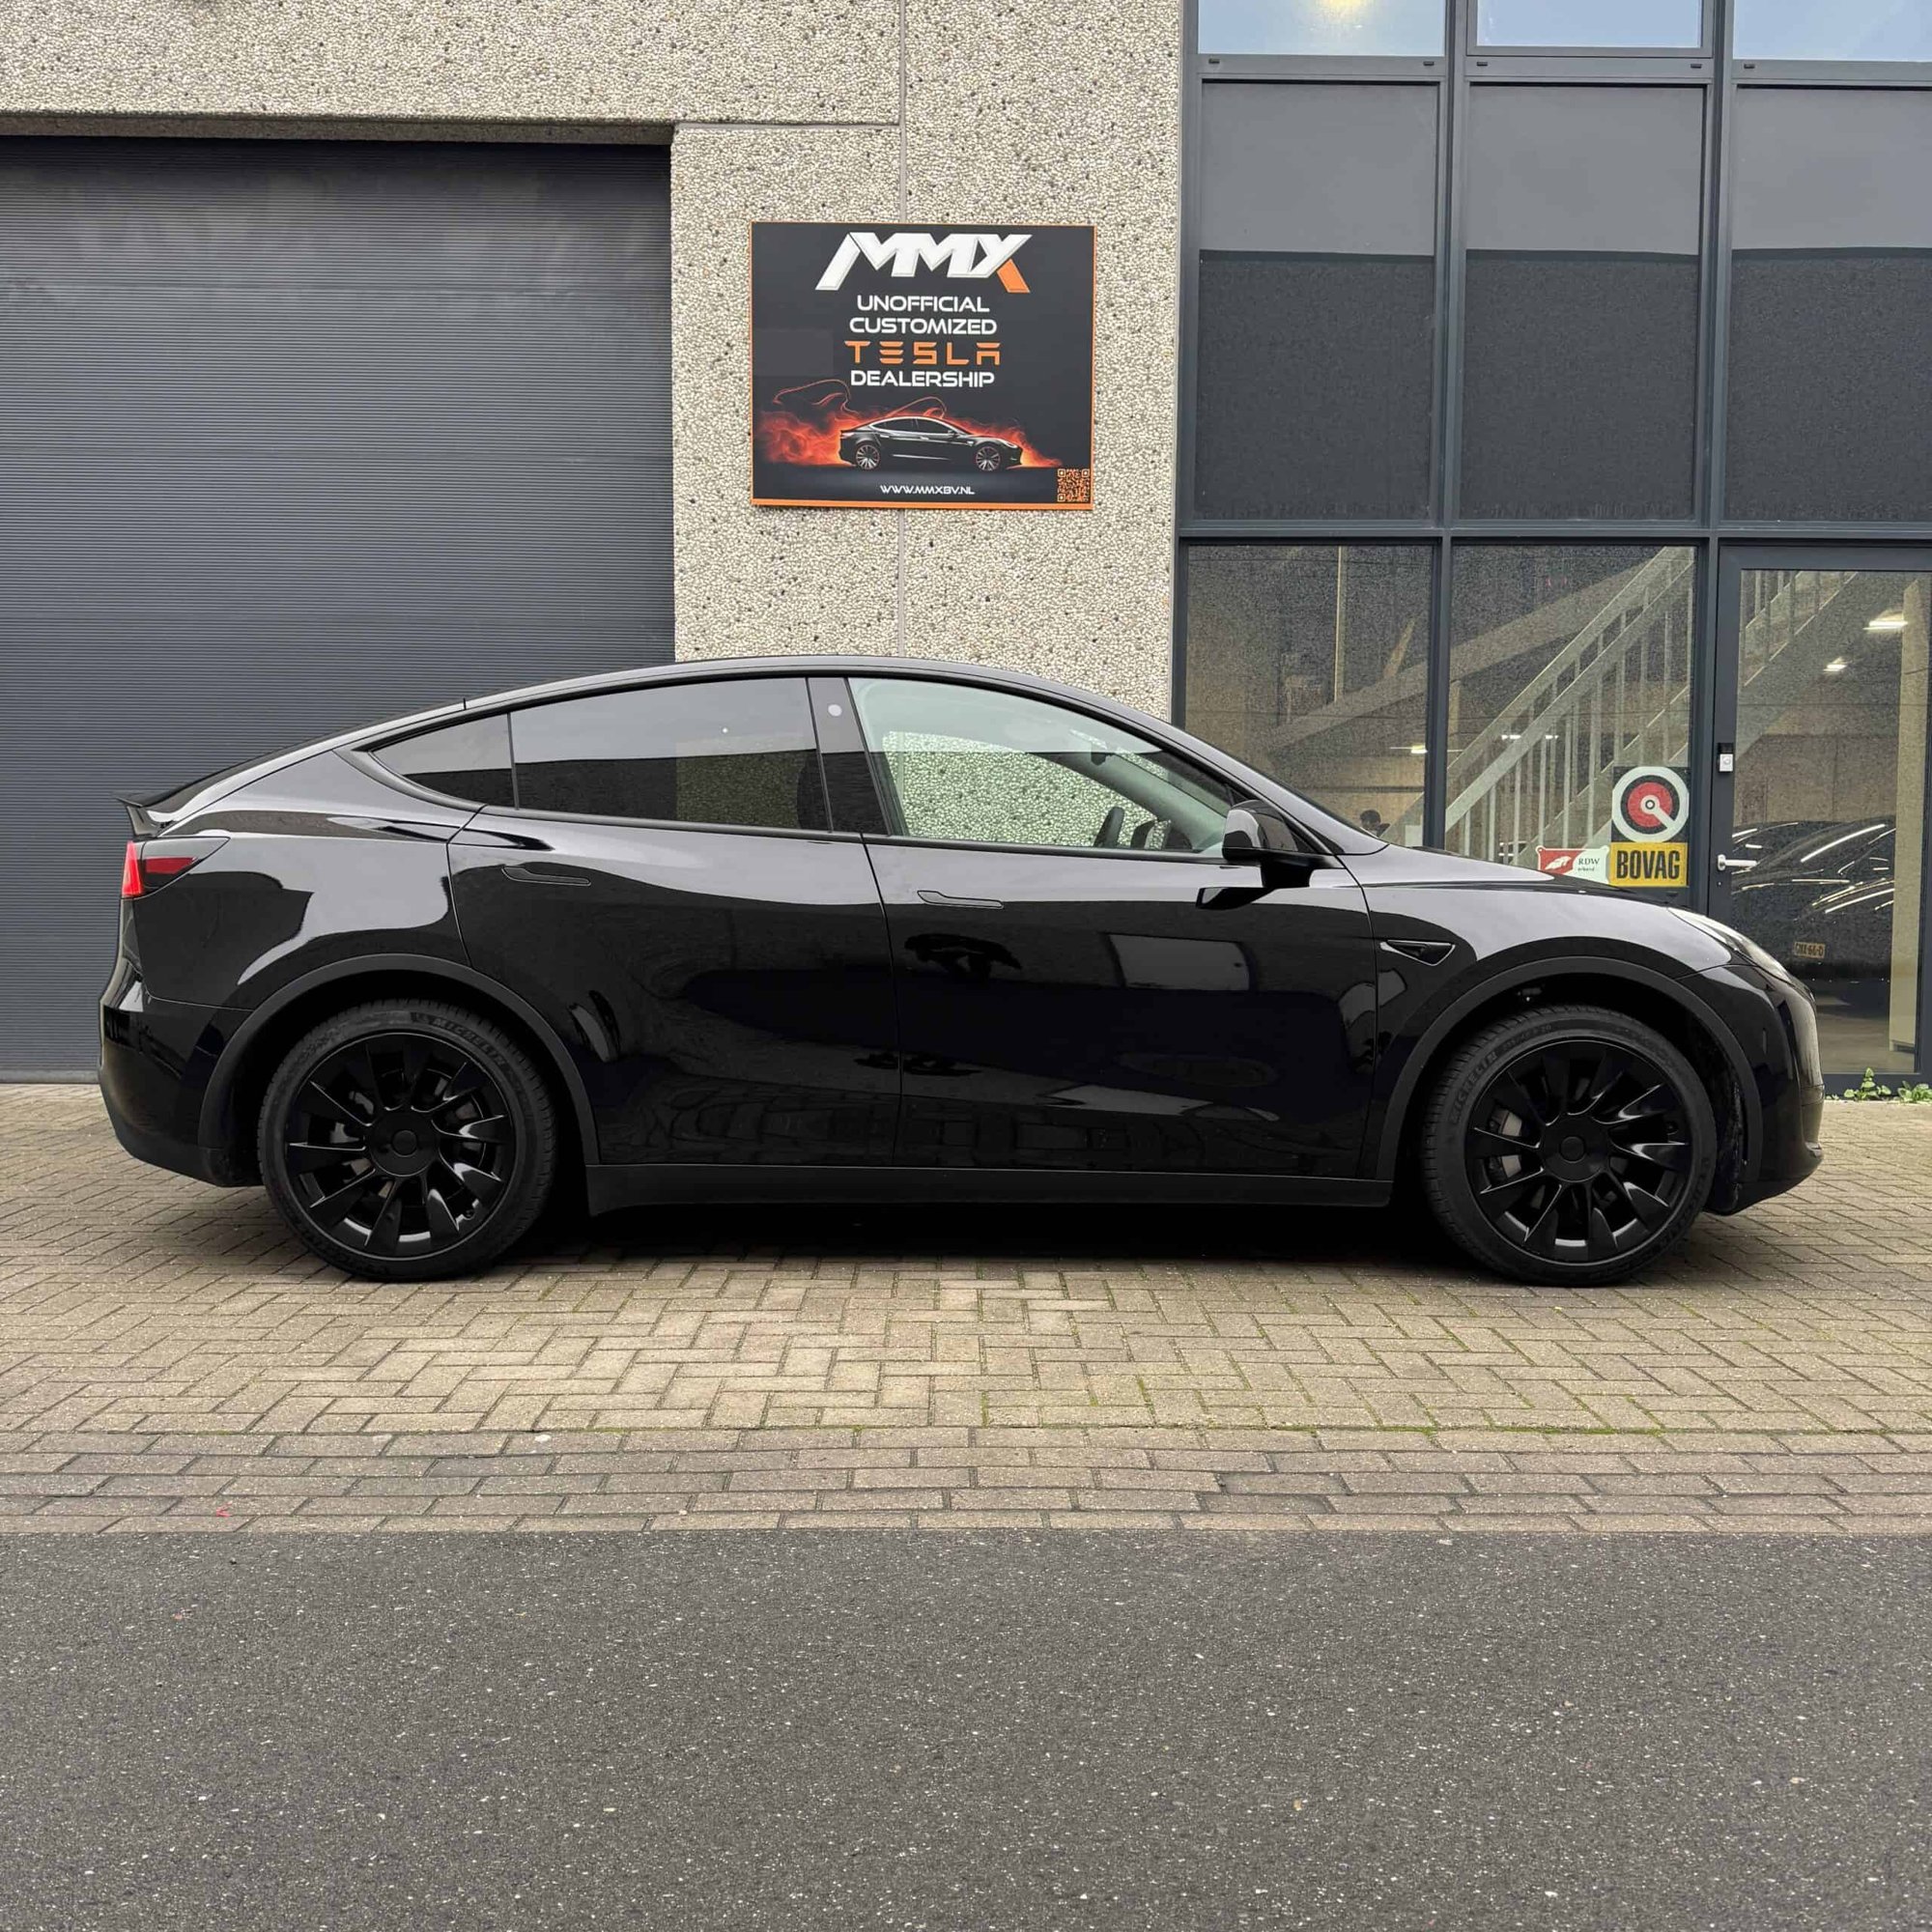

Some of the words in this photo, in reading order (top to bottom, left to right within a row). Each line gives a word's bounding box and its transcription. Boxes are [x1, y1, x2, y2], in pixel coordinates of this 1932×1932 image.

[815, 232, 1033, 293] MMX
[857, 295, 990, 313] UNOFFICIAL
[849, 318, 997, 335] CUSTOMIZED
[844, 340, 1001, 365] TESLA
[851, 370, 995, 388] DEALERSHIP
[880, 485, 976, 495] WWW.MMXBV.NL
[1616, 850, 1681, 880] BOVAG
